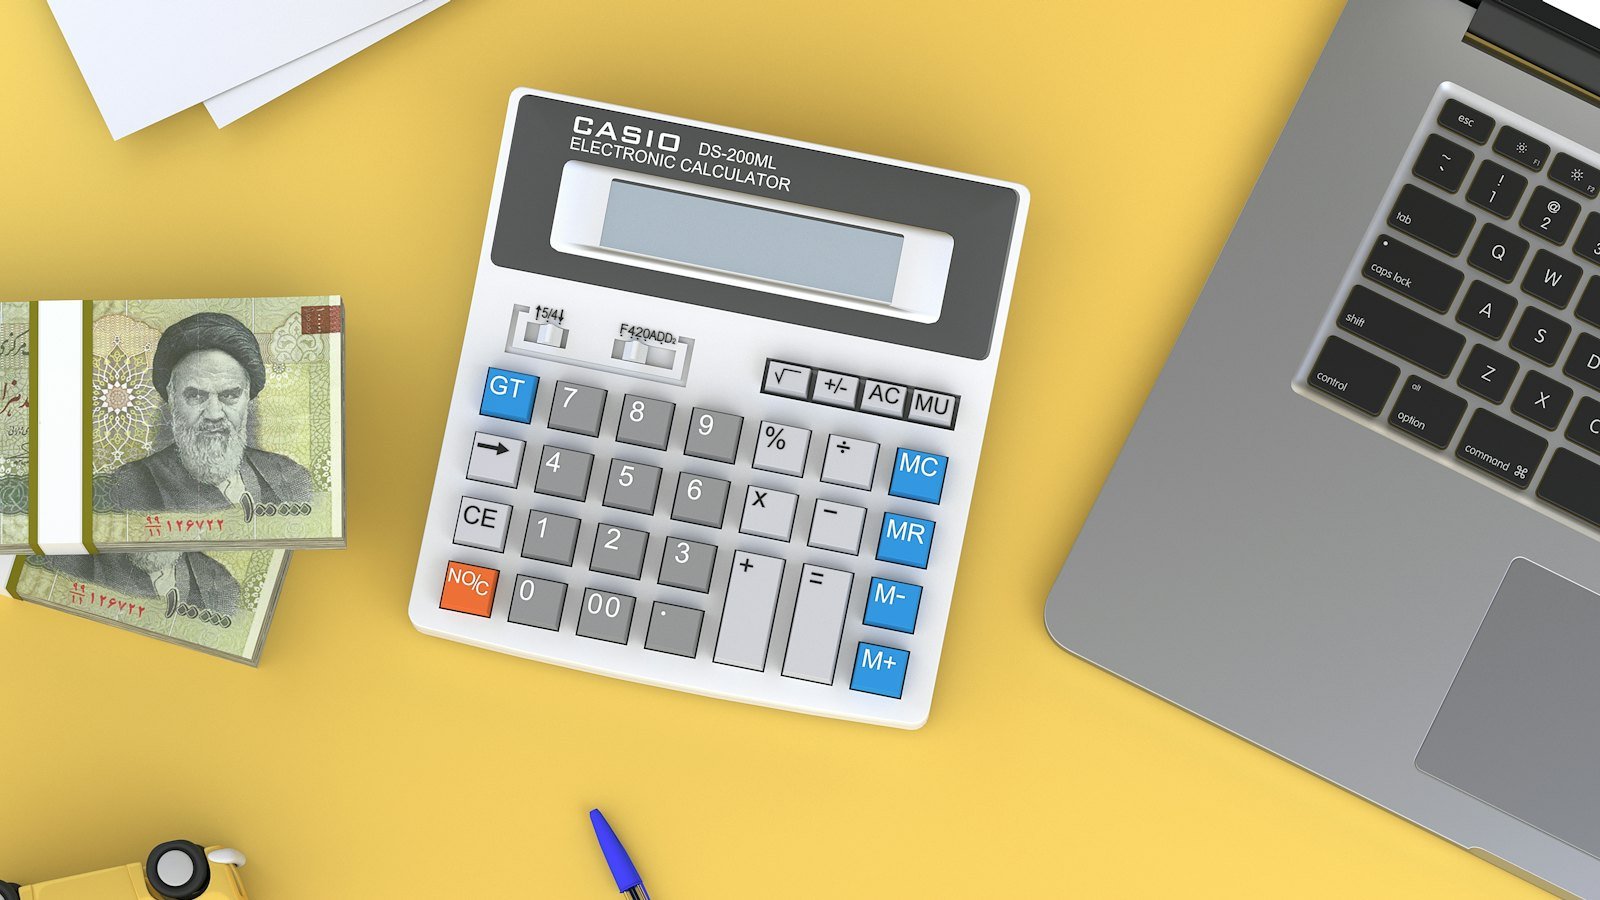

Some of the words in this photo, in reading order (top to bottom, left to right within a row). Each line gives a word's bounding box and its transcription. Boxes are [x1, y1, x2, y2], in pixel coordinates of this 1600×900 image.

[1458, 114, 1475, 127] esc
[573, 115, 681, 152] CASIO
[699, 142, 777, 170] DS-200ML
[569, 136, 676, 169] ELECTRONIC
[680, 158, 791, 192] CALCULATOR
[1532, 158, 1542, 167] F1
[1489, 190, 1497, 203] 1
[1586, 184, 1596, 193] F2
[1396, 211, 1412, 225] tab
[1547, 200, 1561, 214] @
[1540, 216, 1552, 230] 2
[1491, 244, 1506, 262] Q
[1370, 262, 1393, 280] caps
[1393, 271, 1412, 288] lock
[1544, 268, 1563, 287] W
[1345, 313, 1366, 328] shift
[1478, 302, 1492, 319] A
[1534, 328, 1547, 344] S
[1315, 371, 1349, 392] control
[1480, 364, 1497, 382] Z
[489, 375, 525, 398] GT
[563, 386, 578, 408] 7
[868, 385, 901, 405] AC
[1411, 383, 1422, 392] alt
[629, 400, 645, 422] 8
[914, 393, 950, 416] MU
[1534, 391, 1551, 409] X
[698, 414, 714, 436] 9
[1396, 411, 1426, 431] option
[765, 425, 786, 450] %
[545, 451, 561, 473] 4
[899, 452, 939, 477] MC
[1464, 443, 1510, 472] command
[618, 465, 635, 487] 5
[687, 478, 703, 501] 6
[463, 505, 498, 529] CE
[537, 517, 548, 538] 1
[604, 528, 621, 550] 2
[886, 518, 926, 545] MR
[674, 542, 690, 564] 3
[519, 579, 535, 601] 0
[874, 582, 906, 605] M-
[587, 592, 621, 618] 00
[862, 648, 897, 671] M+
